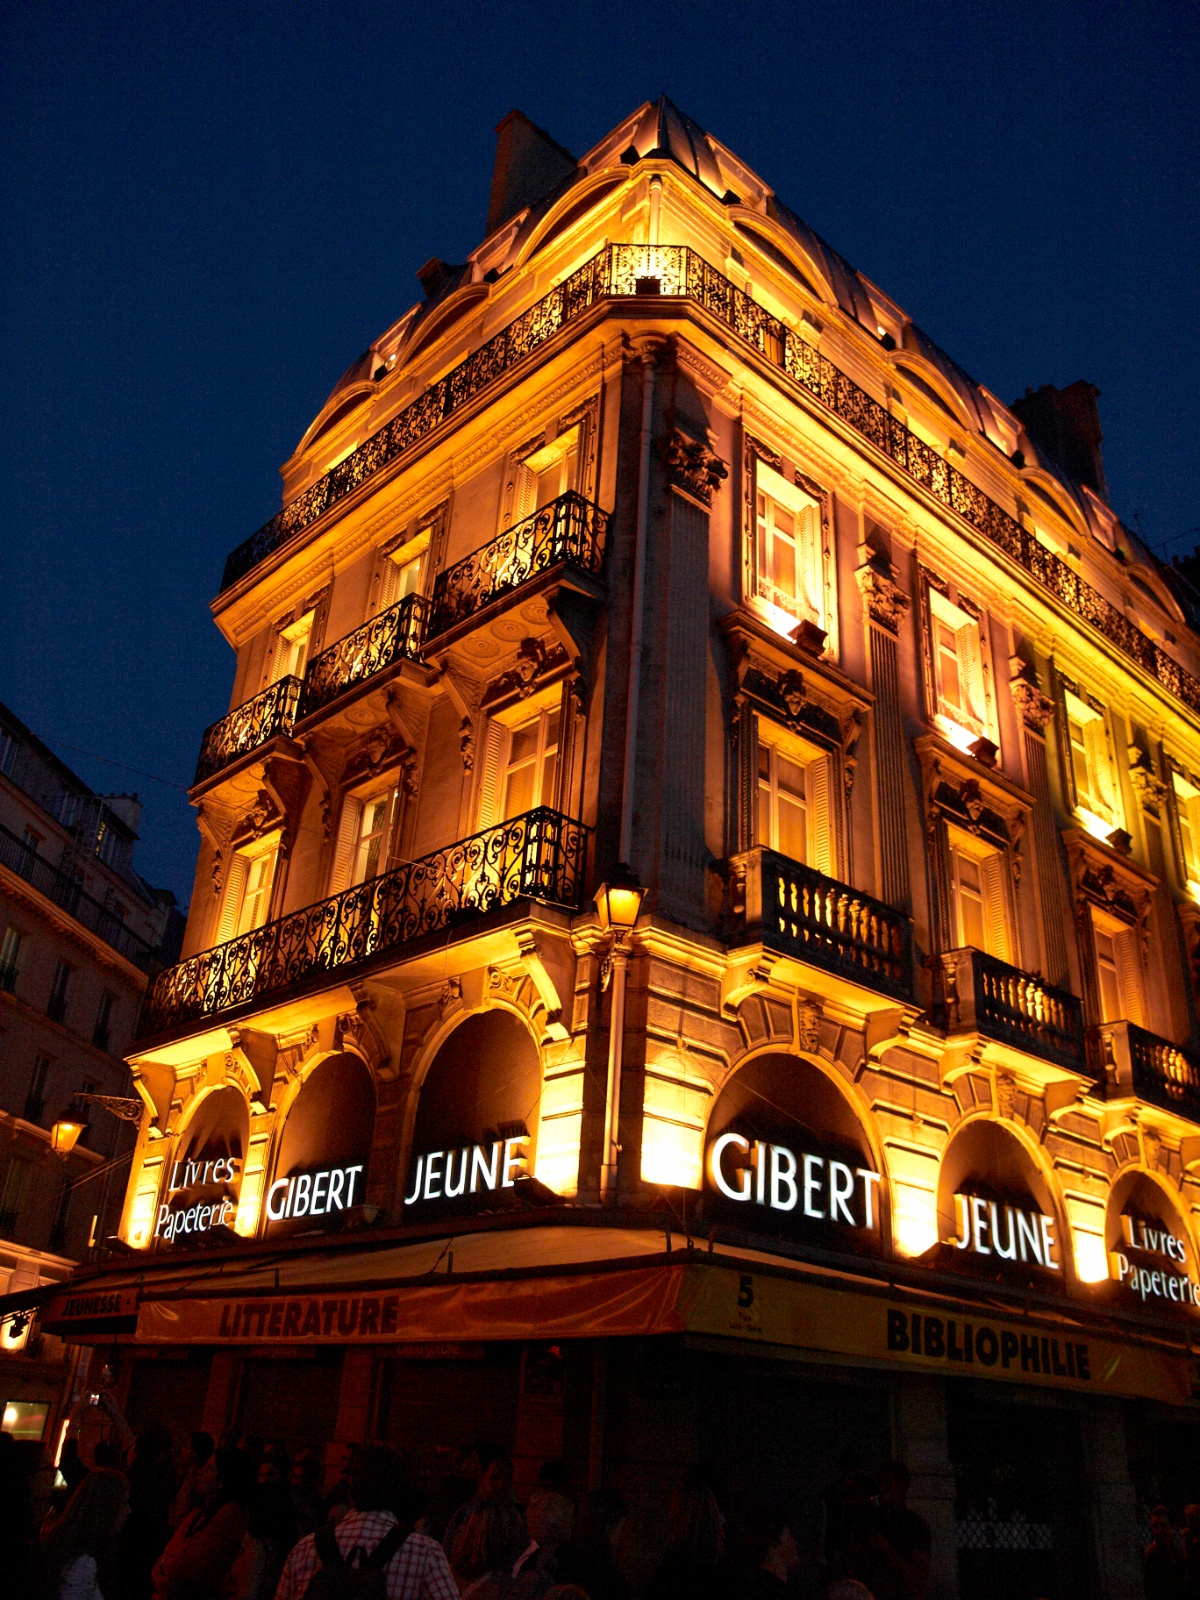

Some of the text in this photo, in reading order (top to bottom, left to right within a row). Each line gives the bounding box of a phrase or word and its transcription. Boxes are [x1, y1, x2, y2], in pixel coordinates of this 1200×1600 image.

[168, 1156, 236, 1192] Livres
[266, 1136, 527, 1221] GIBERT JEUNE
[154, 1198, 234, 1244] Papeterie
[710, 1132, 1059, 1270] GIBERT JEUNE
[1127, 1215, 1186, 1263] Livres
[62, 1295, 121, 1316] JEUNESSE
[738, 1276, 754, 1308] 5
[219, 1296, 400, 1337] LITTERATURE
[887, 1309, 1091, 1380] BIBLIOPHILIE
